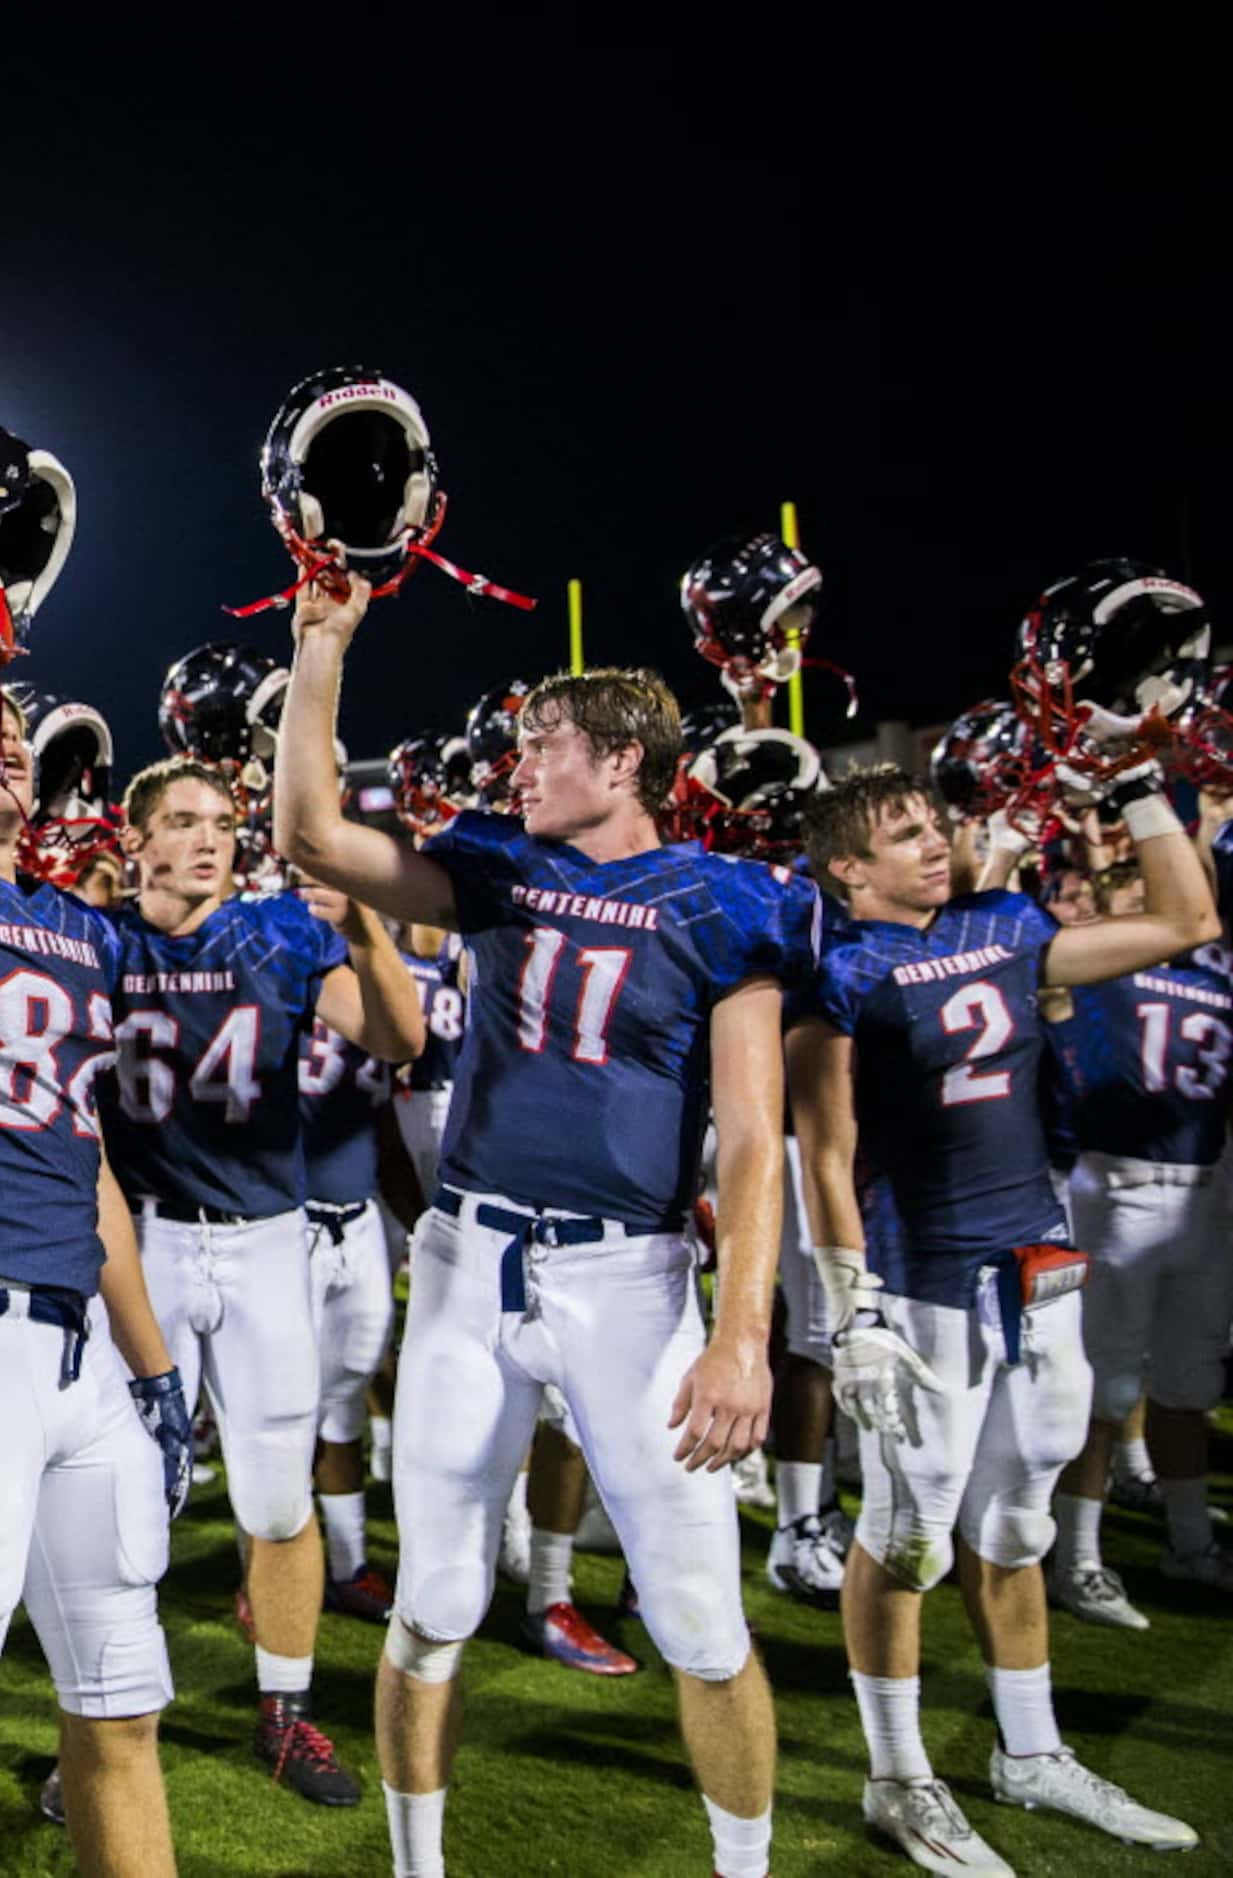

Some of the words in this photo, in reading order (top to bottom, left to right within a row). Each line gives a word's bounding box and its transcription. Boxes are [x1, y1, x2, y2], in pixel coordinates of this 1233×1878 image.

[509, 884, 661, 932] CENTENNIAL
[121, 969, 236, 993] CENTENNIAL
[517, 925, 634, 1066] 11
[892, 943, 1016, 987] CENTENNIAL
[113, 1003, 263, 1125] 64
[939, 980, 1015, 1107] 2
[1135, 1002, 1233, 1100] 13
